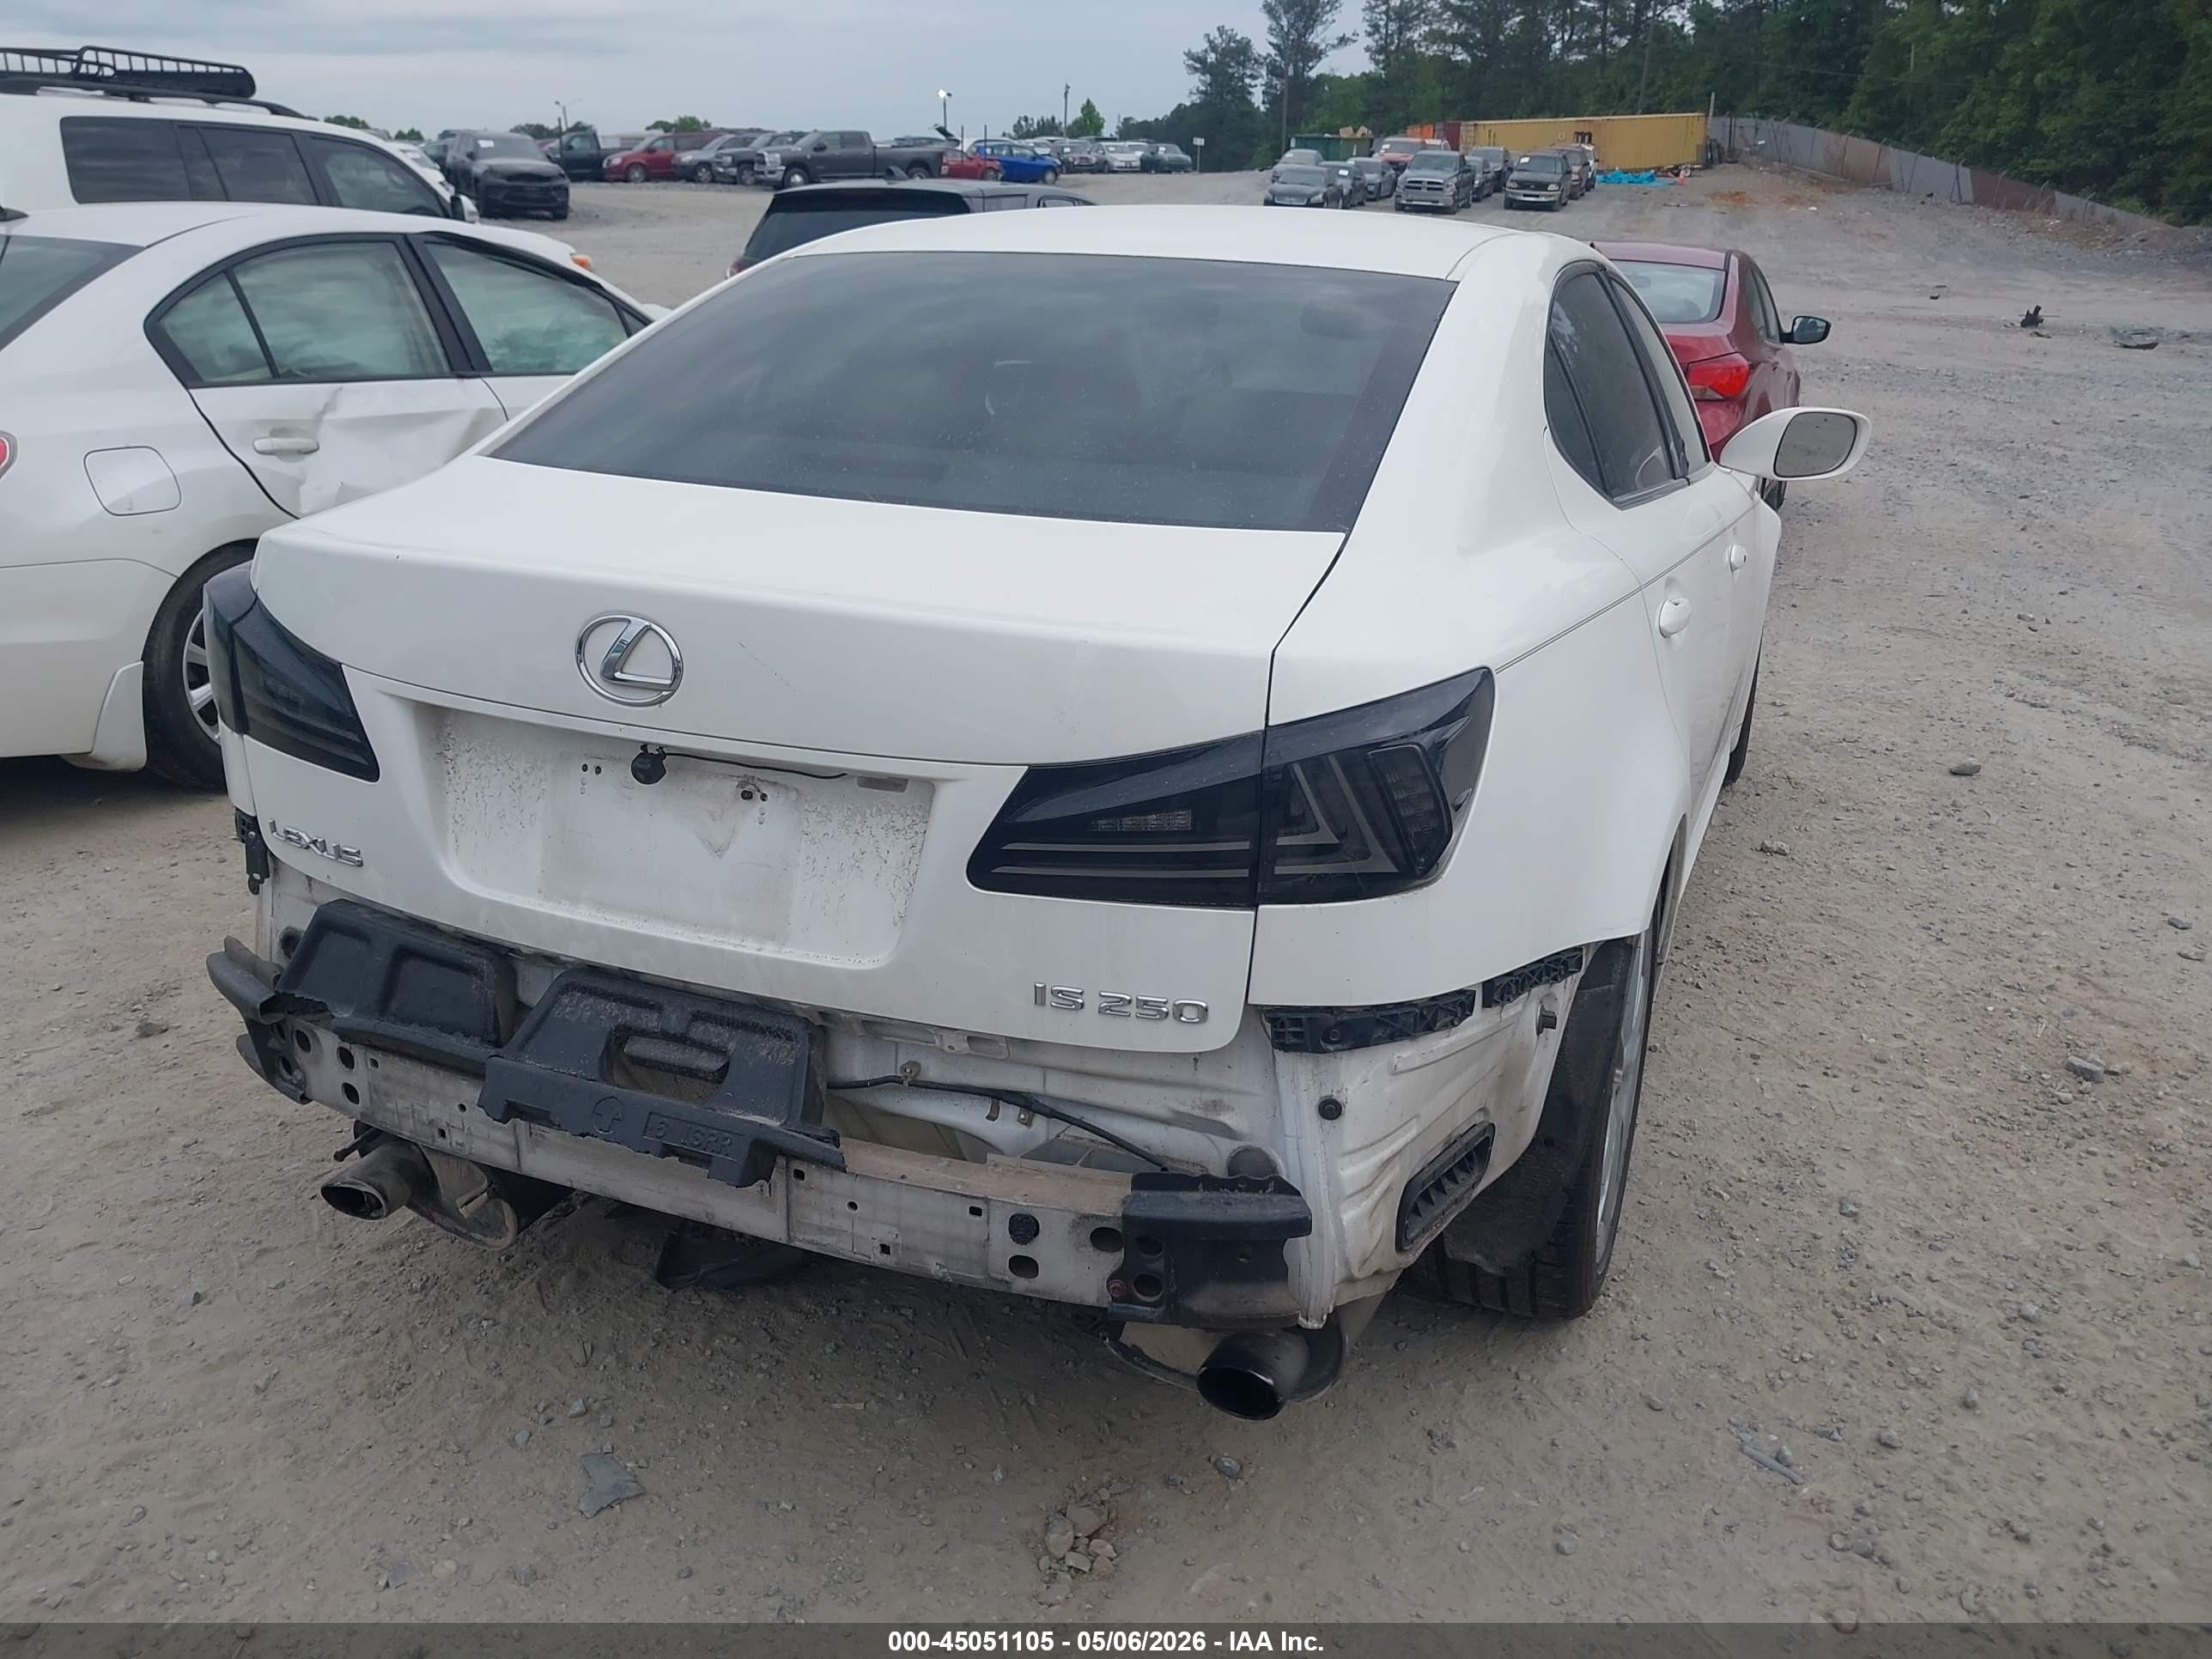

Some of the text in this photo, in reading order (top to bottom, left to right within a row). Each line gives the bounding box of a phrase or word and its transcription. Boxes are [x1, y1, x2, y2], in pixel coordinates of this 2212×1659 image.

[269, 818, 363, 867] LEXUS
[1034, 982, 1208, 1024] IS 250
